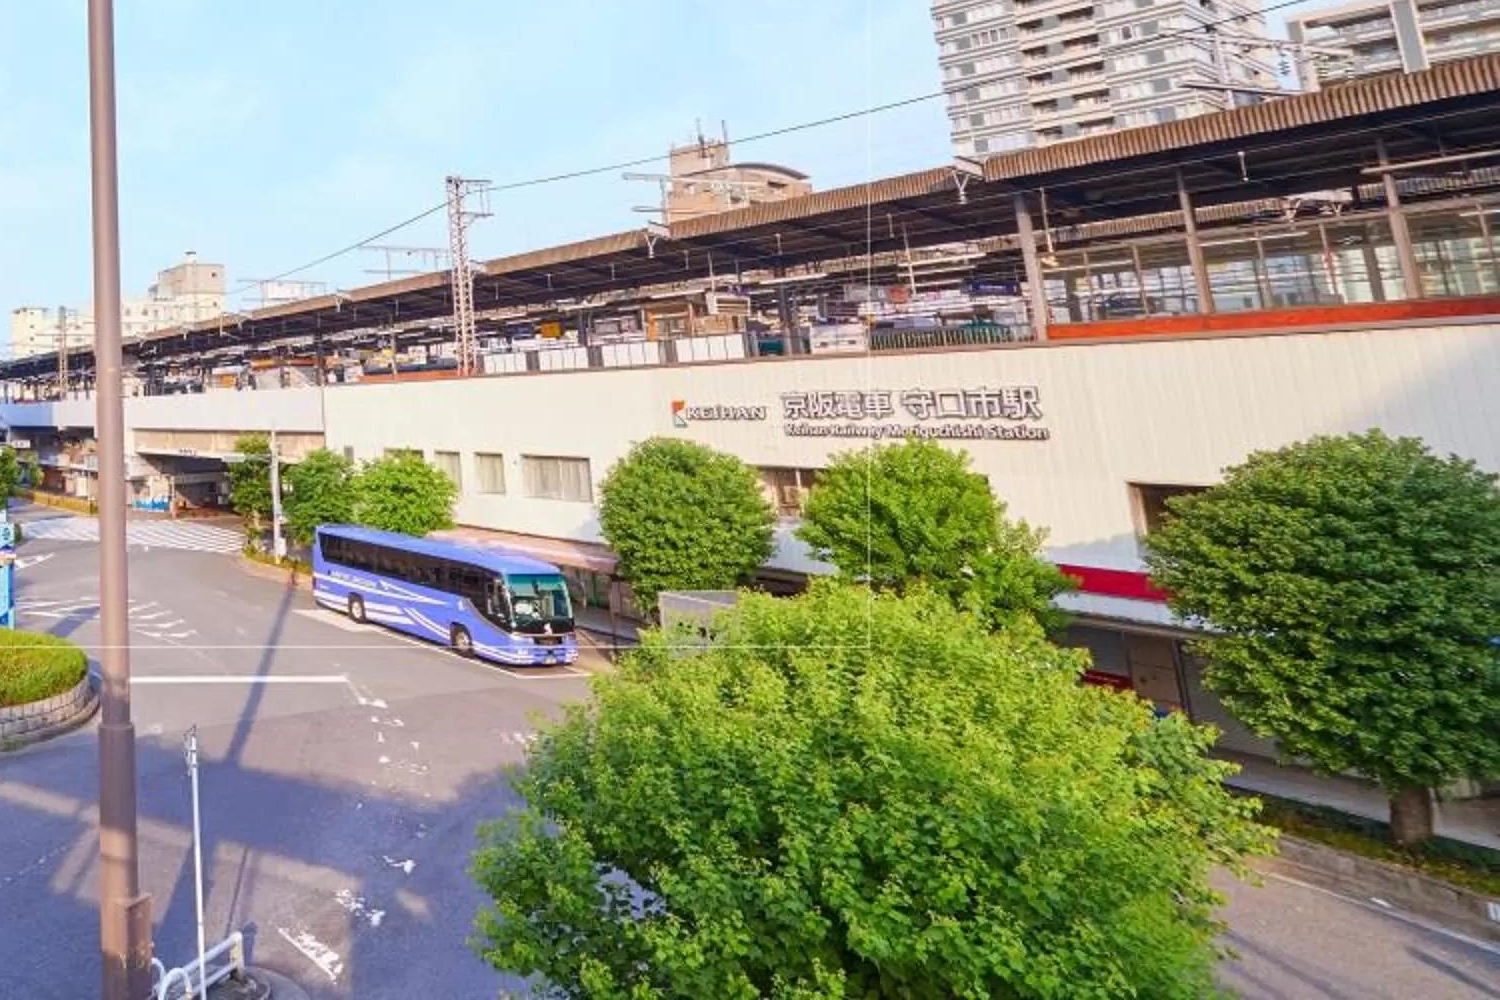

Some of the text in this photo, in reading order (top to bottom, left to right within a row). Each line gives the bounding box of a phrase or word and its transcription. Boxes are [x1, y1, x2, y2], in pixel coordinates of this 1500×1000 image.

[783, 385, 1043, 420] 京阪電車 守口市駅
[988, 423, 1051, 440] Station
